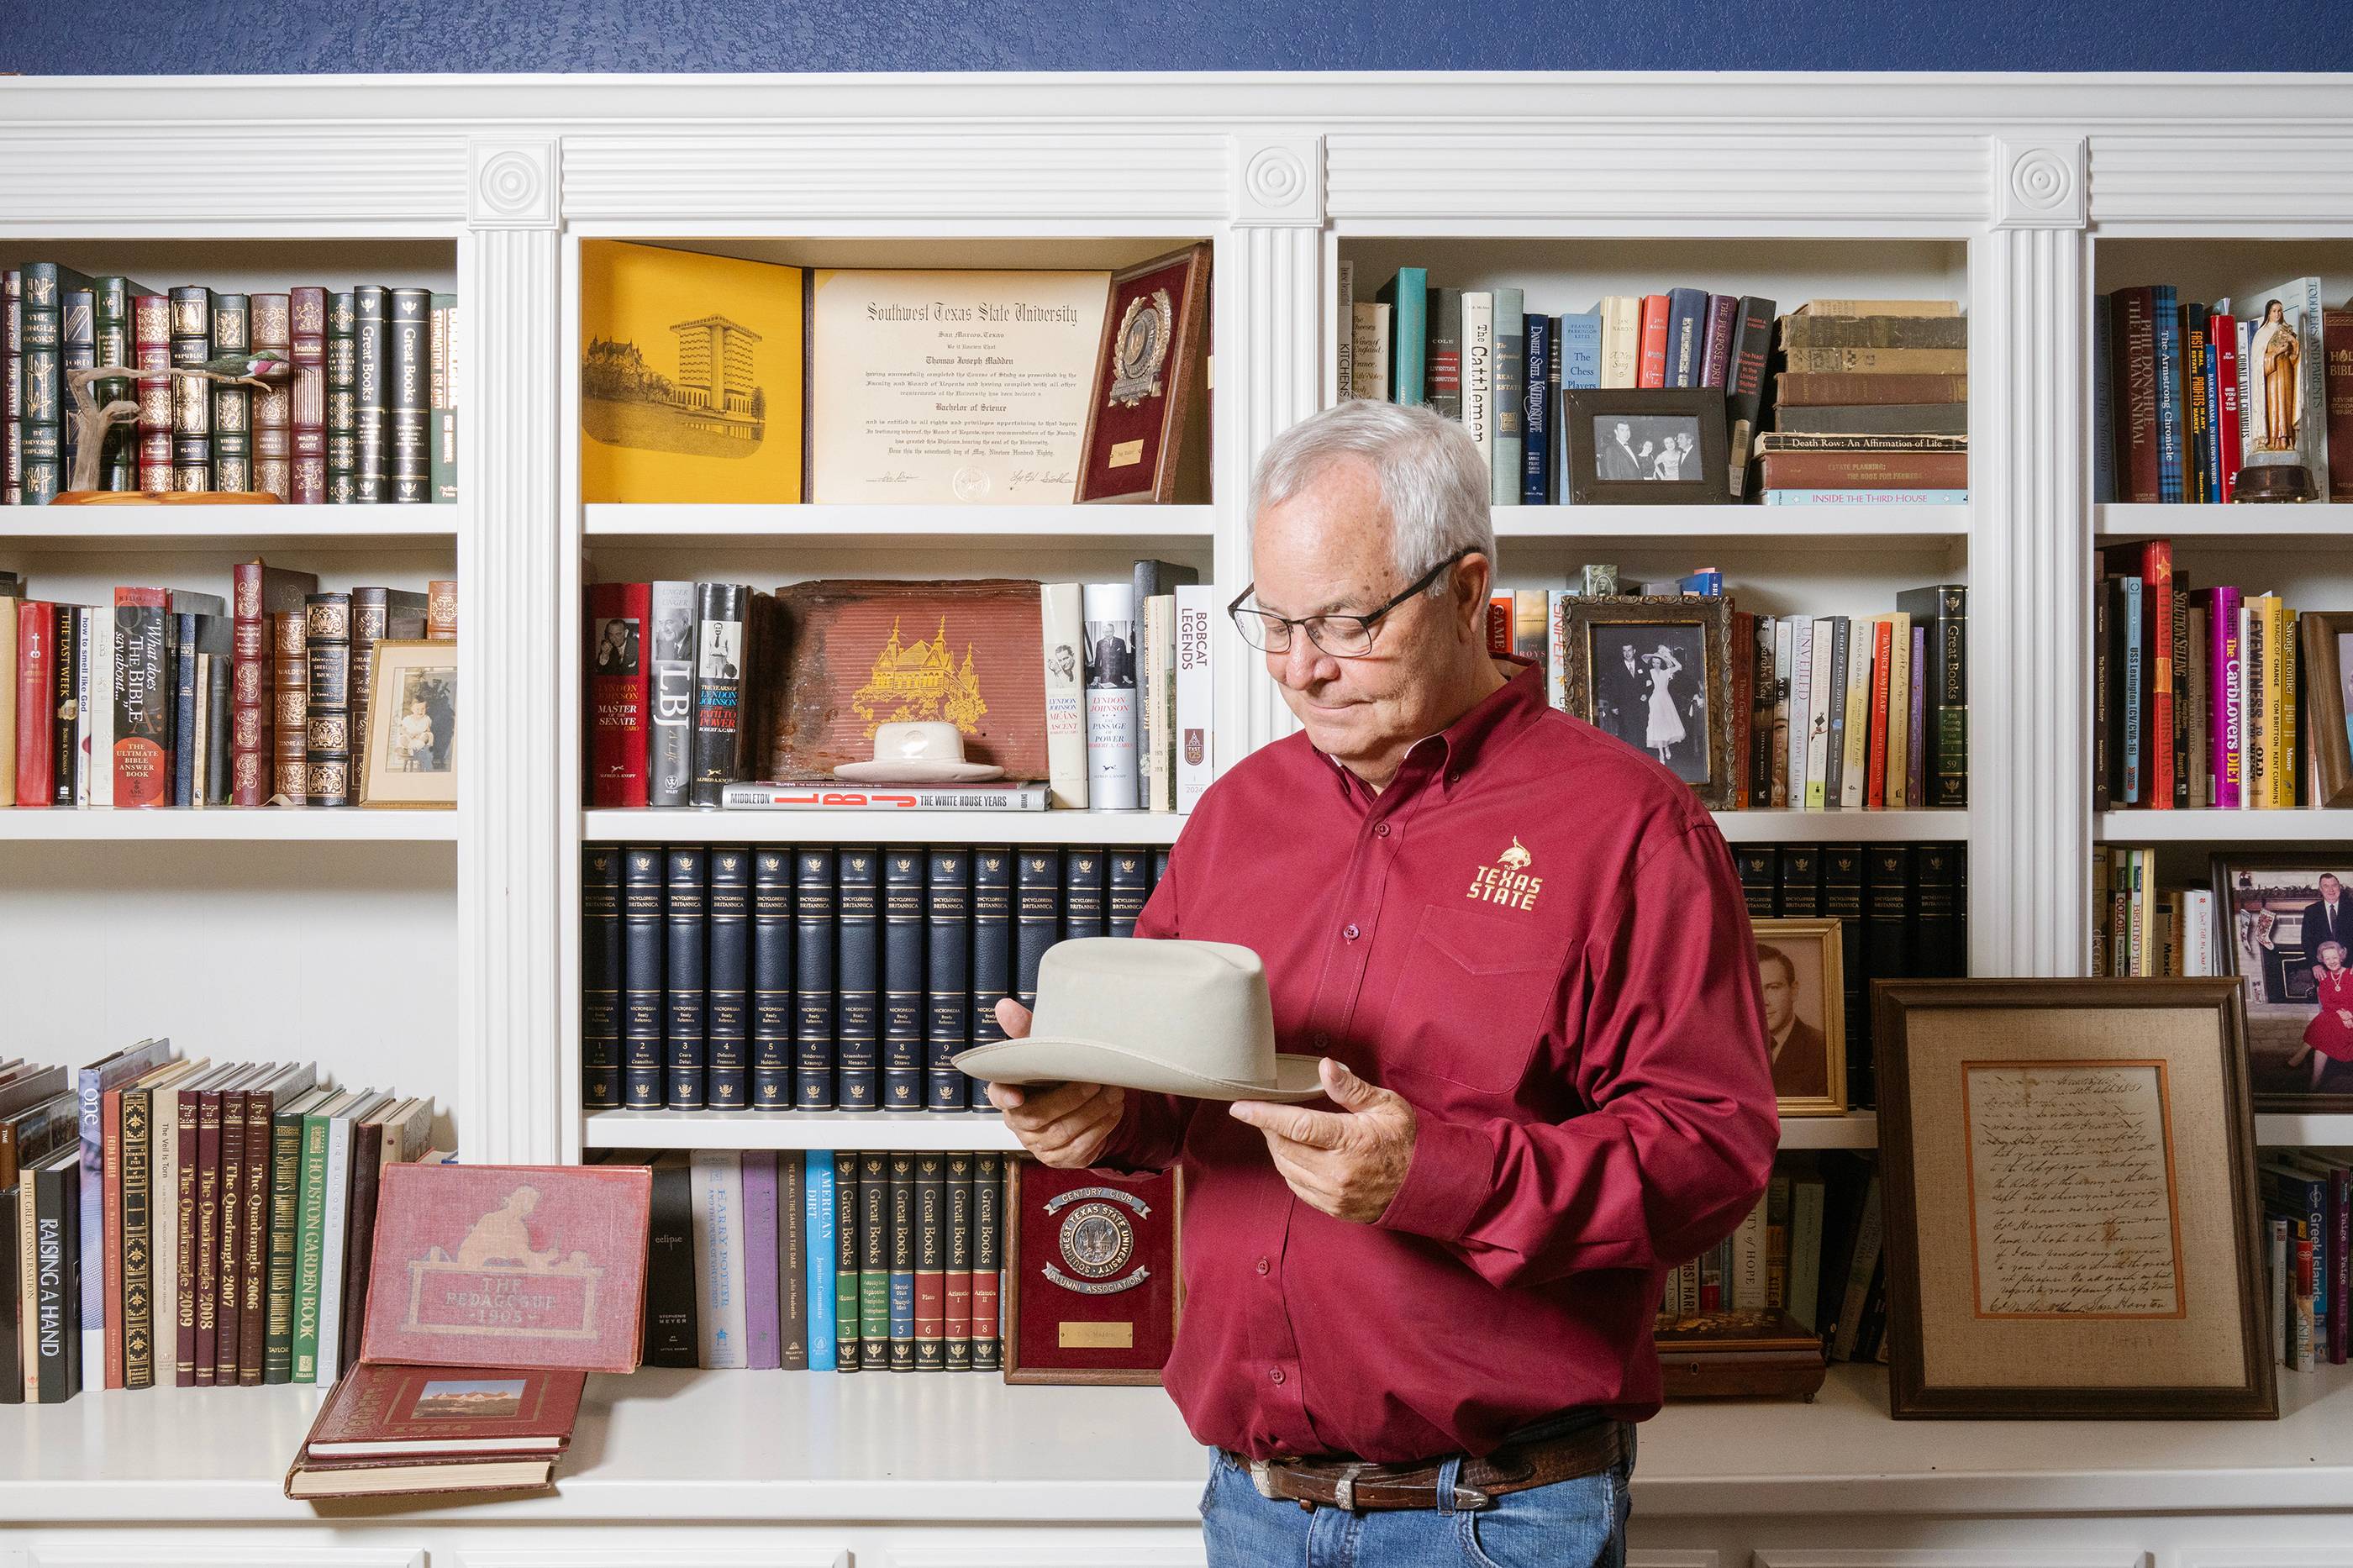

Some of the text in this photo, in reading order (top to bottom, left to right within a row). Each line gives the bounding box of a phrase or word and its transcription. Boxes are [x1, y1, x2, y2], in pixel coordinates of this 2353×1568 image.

[866, 302, 1077, 327] Southwest Texas State University
[294, 343, 322, 353] Ivanhoe
[362, 326, 375, 402] Great Books
[403, 328, 416, 403] Great Books
[925, 356, 1013, 367] Thomas Joseph Madden
[1340, 344, 1350, 397] KITCHENS
[1570, 366, 1594, 376] Chess
[1574, 352, 1591, 361] The
[2129, 298, 2145, 449] THE HUMAN ANIMAL
[1471, 324, 1488, 442] The Cattlemen
[2161, 353, 2171, 408] Armstrong
[935, 403, 1008, 413] Bachelor of Science
[1792, 439, 1943, 448] Death Row: An Affirmation of Life
[2164, 412, 2174, 460] Chronicle
[1813, 494, 1844, 502] INSIDE
[1866, 494, 1897, 502] THIRD
[1900, 494, 1928, 502] HOUSE
[82, 639, 89, 647] to
[1182, 608, 1193, 670] LEGENDS
[1196, 613, 1208, 666] BOBCAT
[1494, 604, 1506, 650] GAME
[2274, 647, 2281, 656] OF
[61, 615, 71, 697] THE LAST WEEK
[129, 636, 145, 723] THE BIBLE
[147, 663, 161, 691] does
[1799, 627, 1812, 700] UNVEILED
[1948, 625, 1960, 700] Great Books
[2130, 647, 2139, 666] USS
[2284, 621, 2295, 697] Savage Frontier
[598, 705, 637, 713] MASTER
[653, 666, 690, 730] LBJ
[698, 698, 737, 707] JOHNSON
[2129, 666, 2139, 706] Lexington
[599, 718, 637, 726] SENATE
[730, 793, 770, 804] MIDDLETON
[920, 795, 933, 807] THE
[934, 795, 958, 807] WHITE
[960, 795, 982, 808] HOUSE
[983, 795, 1008, 808] YEARS
[1466, 882, 1537, 911] STATE
[1476, 866, 1543, 894] TEXAS
[83, 1088, 99, 1126] one
[25, 1202, 34, 1230] GREAT
[808, 1190, 817, 1219] DIRT
[822, 1170, 832, 1239] AMERICAN
[1061, 1187, 1134, 1203] CENTURY CLUB
[177, 1164, 195, 1327] The Quadrangle 2009
[198, 1166, 216, 1330] The Quadrangle 2008
[220, 1162, 238, 1308] The Quadrangle 2007
[246, 1164, 263, 1310] The Quadrangle 2006
[300, 1158, 323, 1340] HOUSTON GARDEN BOOK
[655, 1234, 683, 1251] eclipse
[718, 1189, 729, 1307] HARRY POTTER
[842, 1190, 854, 1265] Great Books
[869, 1189, 882, 1265] Great Books
[897, 1189, 908, 1265] Great Books
[924, 1189, 936, 1265] Great Books
[1061, 1206, 1130, 1275] SOUTHWEST TEXAS STATE UNIVERSITY
[25, 1231, 34, 1299] CONVERSATION
[1050, 1274, 1142, 1292] ALUMNI ASSOCIATION
[1745, 1250, 1756, 1285] HOPE
[2311, 1213, 2322, 1303] Greek Islands
[40, 1218, 60, 1357] RAISING A HAND
